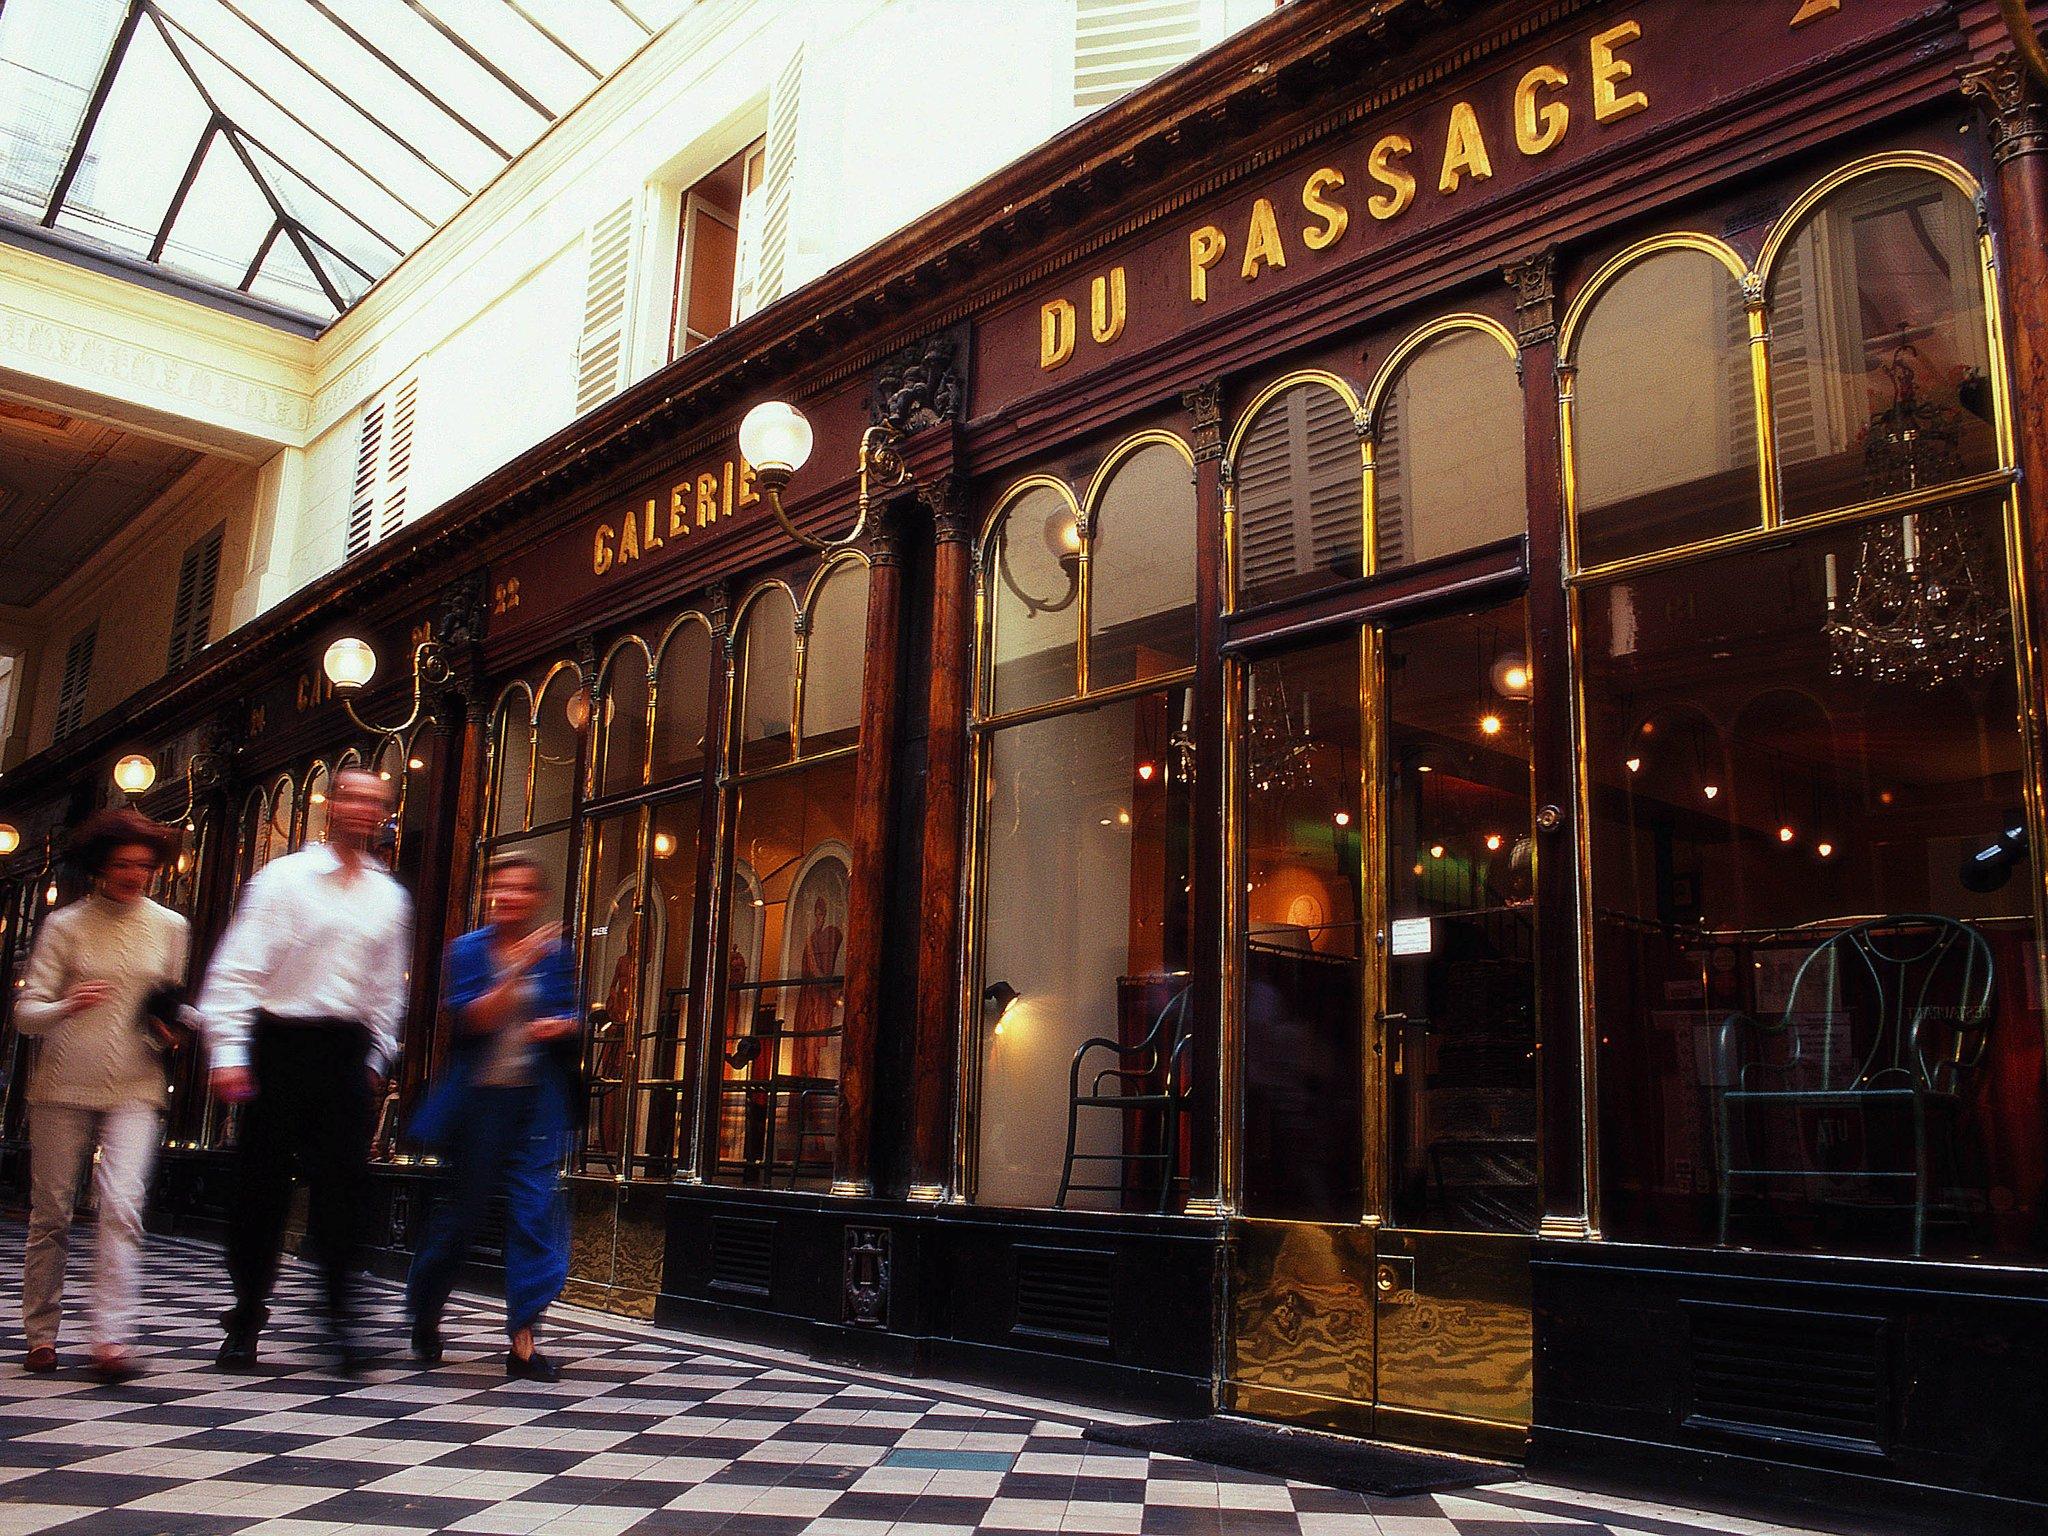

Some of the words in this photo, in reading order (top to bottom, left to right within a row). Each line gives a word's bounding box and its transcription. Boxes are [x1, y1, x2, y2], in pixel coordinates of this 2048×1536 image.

[1041, 266, 1127, 371] DU
[1189, 20, 1649, 302] PASSAGE
[594, 454, 761, 576] GALERIE
